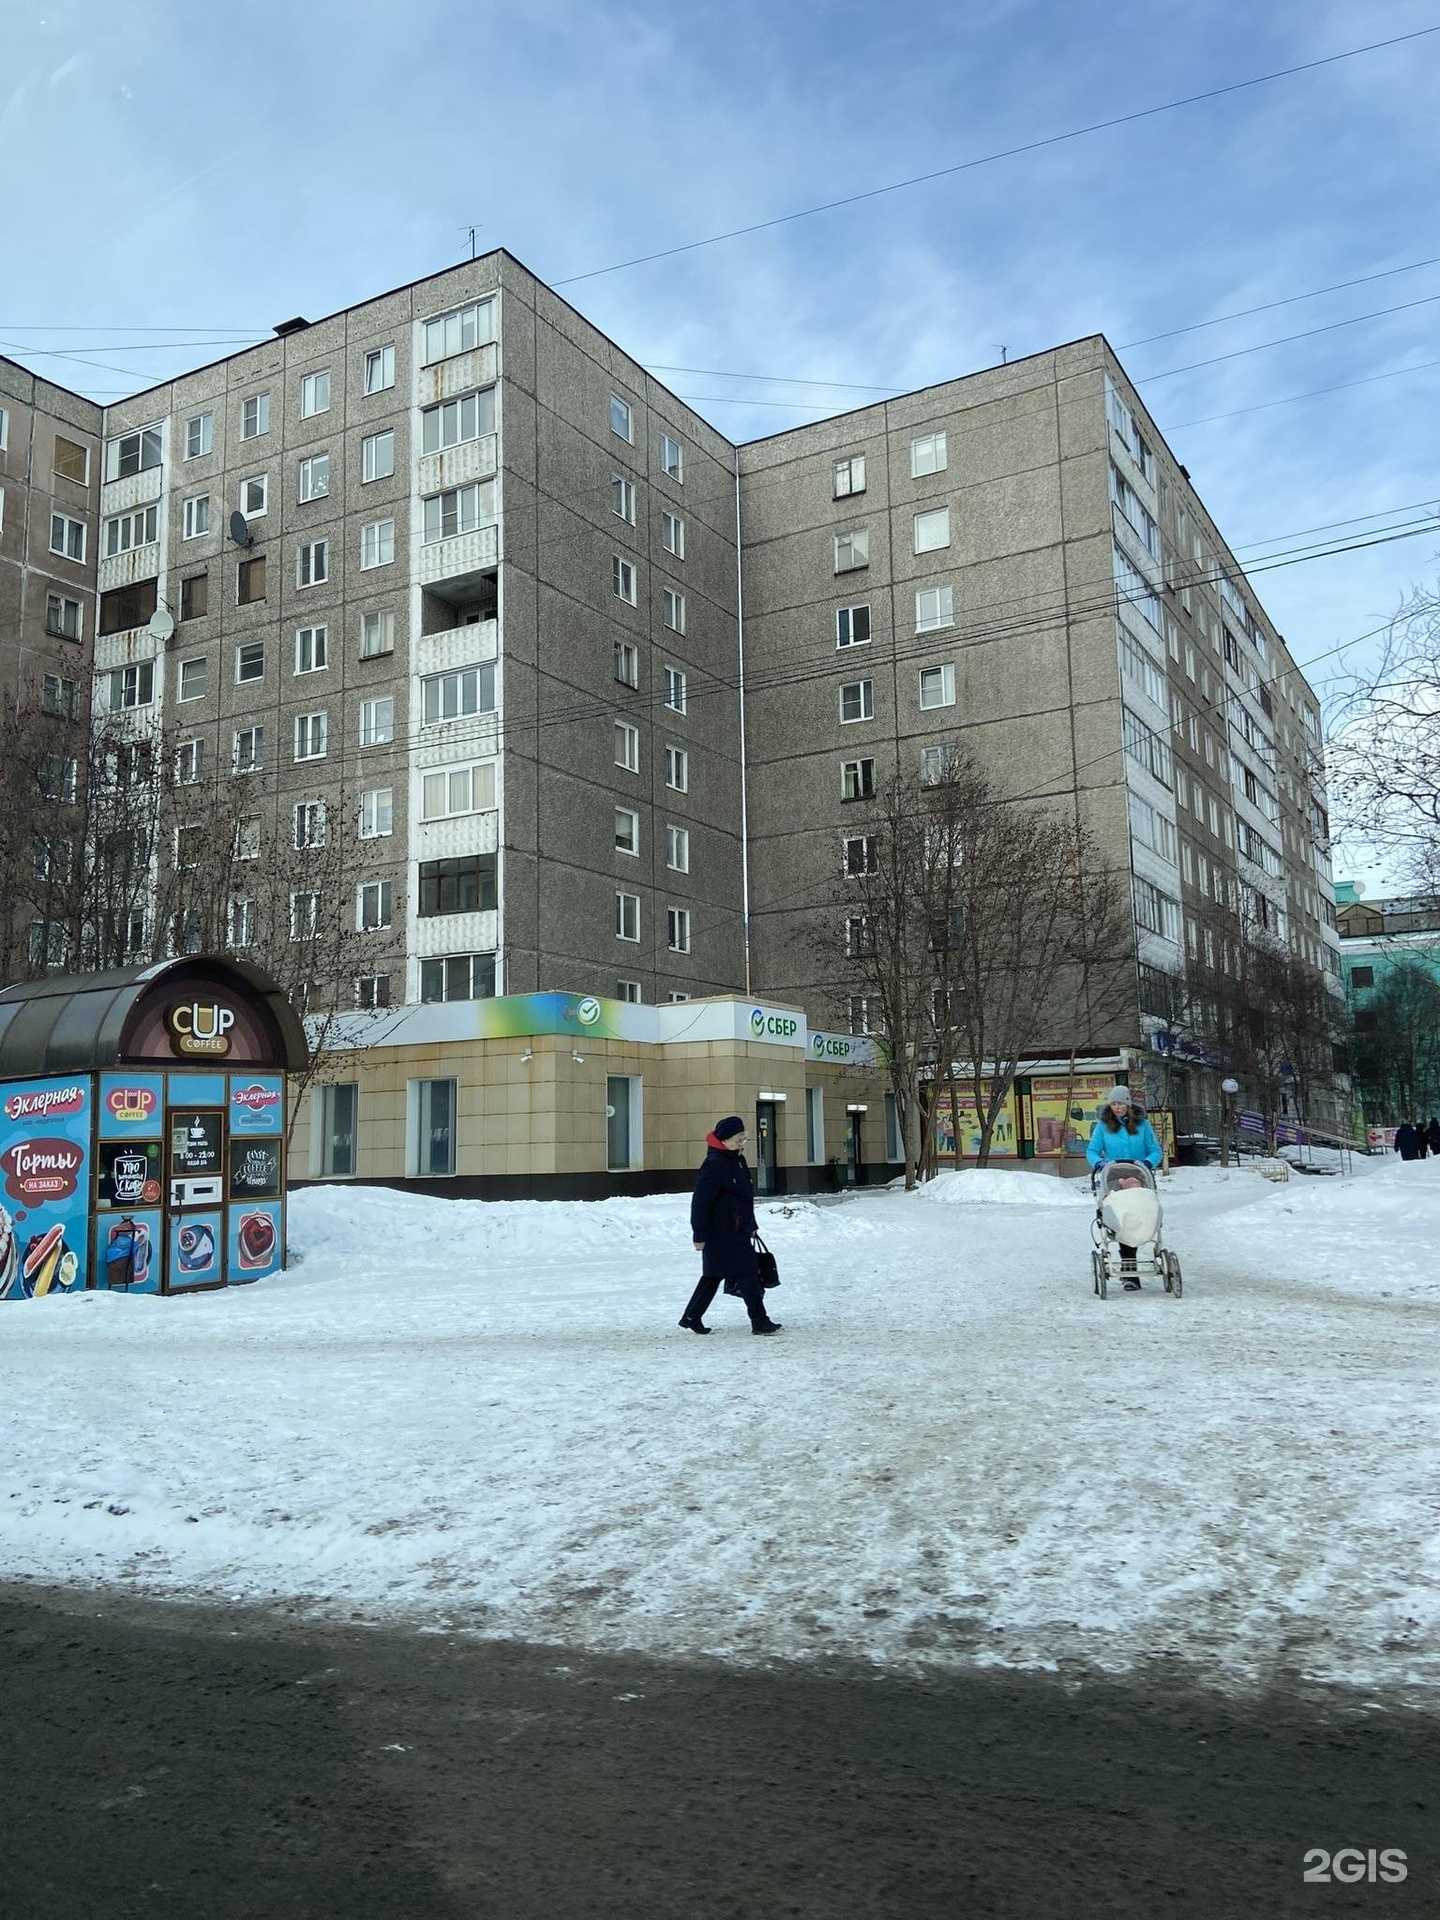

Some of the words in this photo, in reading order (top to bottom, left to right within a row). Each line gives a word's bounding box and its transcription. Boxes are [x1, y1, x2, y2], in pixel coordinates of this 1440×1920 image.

[173, 1003, 235, 1039] CUP
[767, 1017, 797, 1036] СБЕР
[826, 1039, 850, 1056] СБЕР
[11, 1086, 78, 1119] Эклерная
[110, 1089, 152, 1111] CUP
[11, 1143, 78, 1177] Торты
